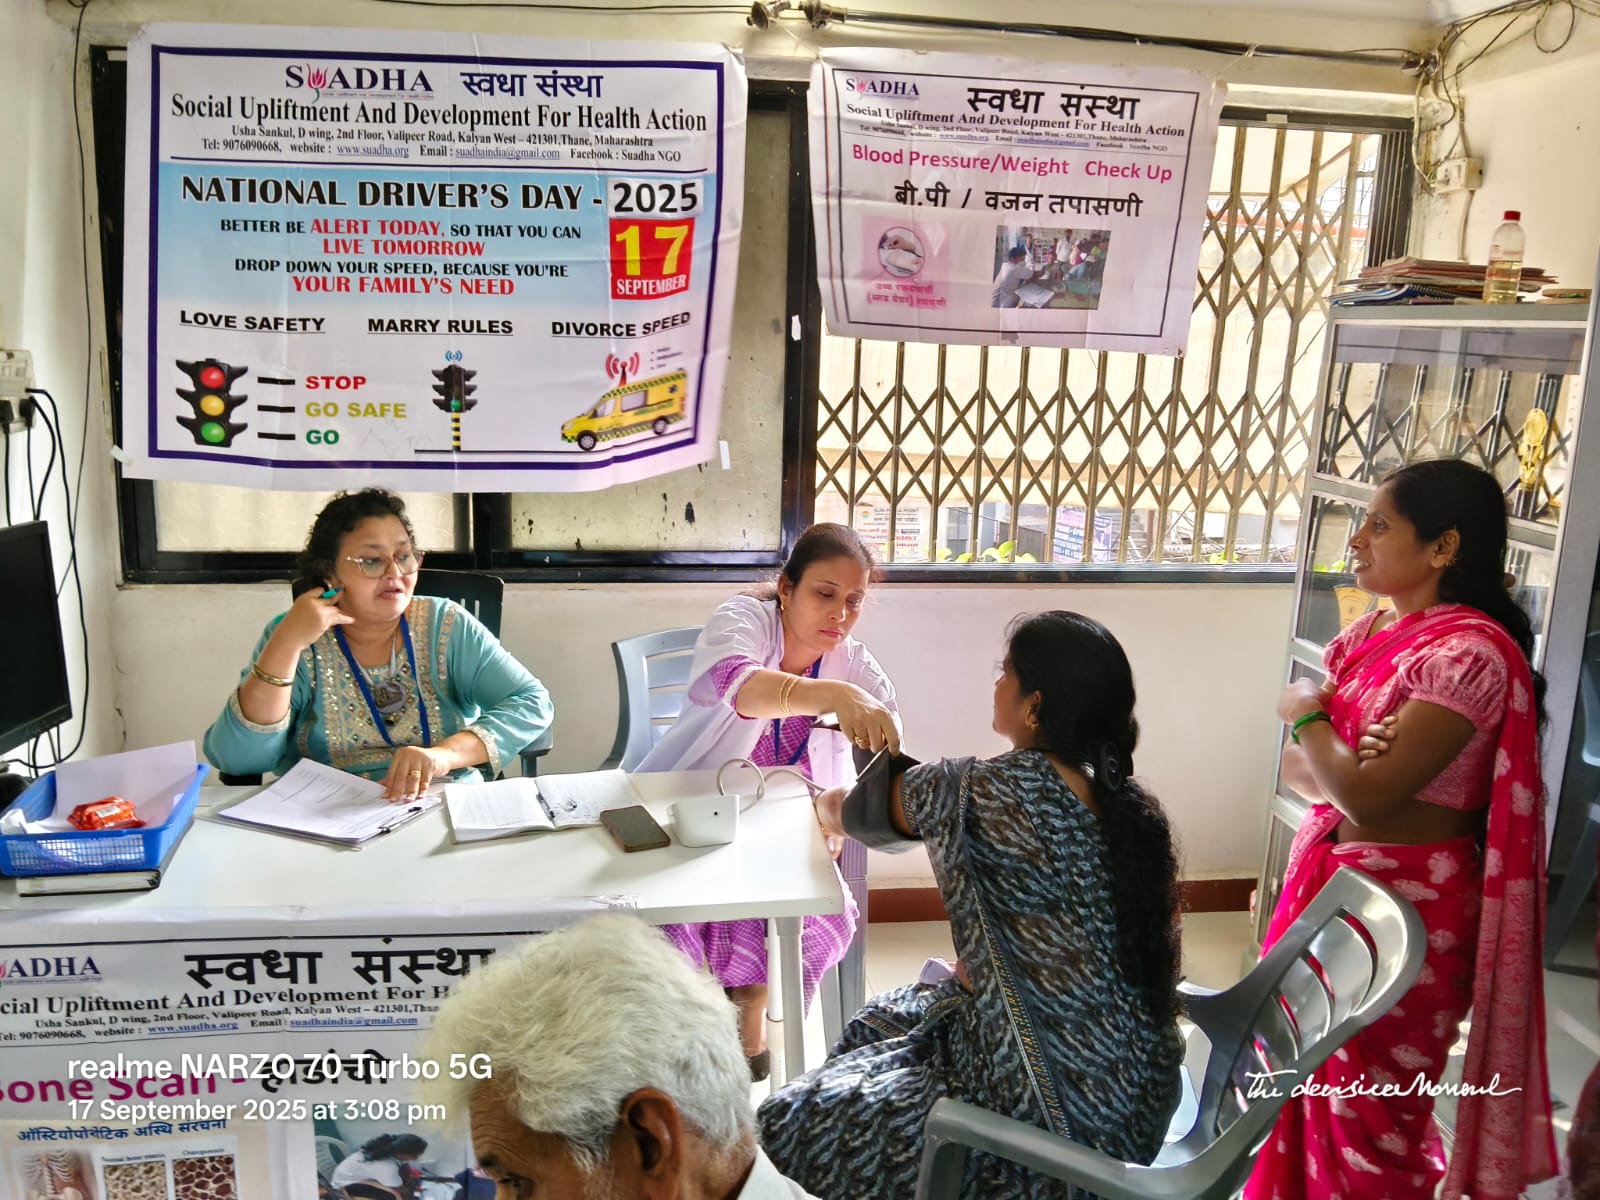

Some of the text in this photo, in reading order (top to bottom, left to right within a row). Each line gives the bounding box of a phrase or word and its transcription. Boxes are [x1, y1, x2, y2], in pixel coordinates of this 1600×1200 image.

[460, 72, 527, 97] स्वधा
[534, 70, 604, 98] संस्था
[171, 93, 707, 131] Social Upliftment And Development For Health Action
[967, 85, 1140, 120] स्वधा संस्था
[847, 104, 1185, 137] Social Upliftment And Development For Health Action
[232, 124, 256, 137] Usha
[259, 125, 296, 139] Sankul,
[298, 128, 306, 138] D
[308, 128, 334, 142] wing,
[336, 128, 354, 140] 2nd
[357, 129, 385, 142] Floor,
[387, 130, 426, 145] Valipeer
[428, 131, 455, 144] Road,
[458, 133, 491, 147] Kalyan
[493, 134, 517, 145] West
[594, 135, 653, 148] Maharashtra
[201, 138, 681, 162] Tel: 9076090668, website www.suadha.org Email suadhaindia@gmail.com Facebook Suadha NGO
[853, 144, 1172, 184] Blood Pressure/Weight Check Up
[182, 175, 347, 206] NATIONAL
[521, 184, 584, 211] DAY
[612, 182, 698, 213] 2025
[894, 179, 1143, 217] बी.पी / वजन तपासणी
[220, 218, 581, 239] BETTER BE ALERT TODAY, SO THAT YOU CAN
[323, 238, 485, 257] LIVE TOMORROW
[615, 225, 689, 276] 17
[235, 258, 569, 278] DROP DOWN YOUR SPEED, BECAUSE YOU'RE
[293, 276, 350, 293] YOUR
[461, 278, 514, 295] NEED
[616, 274, 686, 296] SEPTEMBER
[180, 310, 326, 332] LOVE SAFETY
[368, 318, 513, 334] MARRY RULES
[552, 311, 691, 337] DIVORCE SPEED
[305, 375, 367, 390] STOP
[305, 402, 407, 418] GO SAFE
[305, 430, 340, 445] GO
[184, 948, 323, 990] स्वधा
[47, 995, 169, 1017] Upliftment
[177, 989, 225, 1009] And
[233, 987, 379, 1006] Development
[386, 986, 425, 1000] For
[35, 1019, 62, 1029] Usha
[65, 1016, 106, 1028] Sankul,
[109, 1017, 118, 1025] D
[121, 1014, 151, 1026] wing,
[153, 1012, 174, 1022] 2nd
[177, 1011, 209, 1022] Floor,
[212, 1010, 258, 1021] Valipeer
[260, 1008, 292, 1018] Road,
[294, 1006, 332, 1018] Kalyan
[335, 1005, 361, 1015] West
[95, 1025, 135, 1037] website
[148, 1021, 239, 1035] www.suadha.org
[250, 1019, 281, 1028] Email
[289, 1016, 418, 1028] suadhaindia@gmail.com
[108, 1070, 216, 1101] Scan
[134, 1121, 173, 1137] अस्थि
